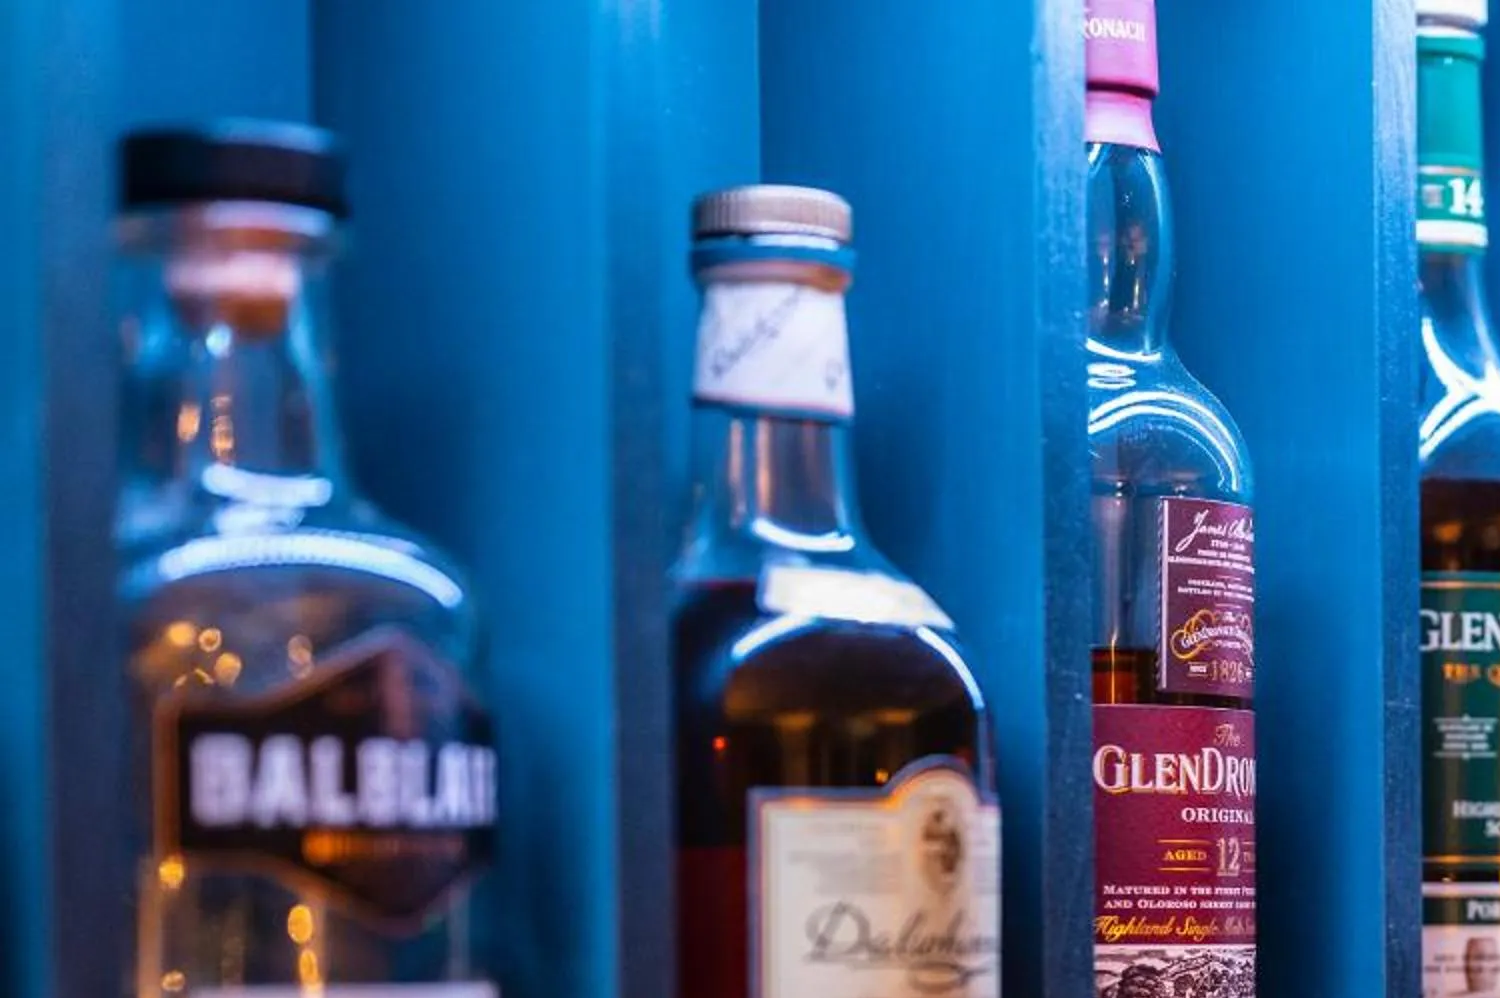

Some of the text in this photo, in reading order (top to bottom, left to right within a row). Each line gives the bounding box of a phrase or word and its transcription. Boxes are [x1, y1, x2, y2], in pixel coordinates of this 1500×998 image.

[1448, 177, 1484, 218] 14
[1163, 849, 1207, 861] AGED
[1215, 837, 1240, 877] 12
[1103, 885, 1171, 895] MATURED
[1173, 886, 1187, 895] IN
[1104, 899, 1134, 909] AND
